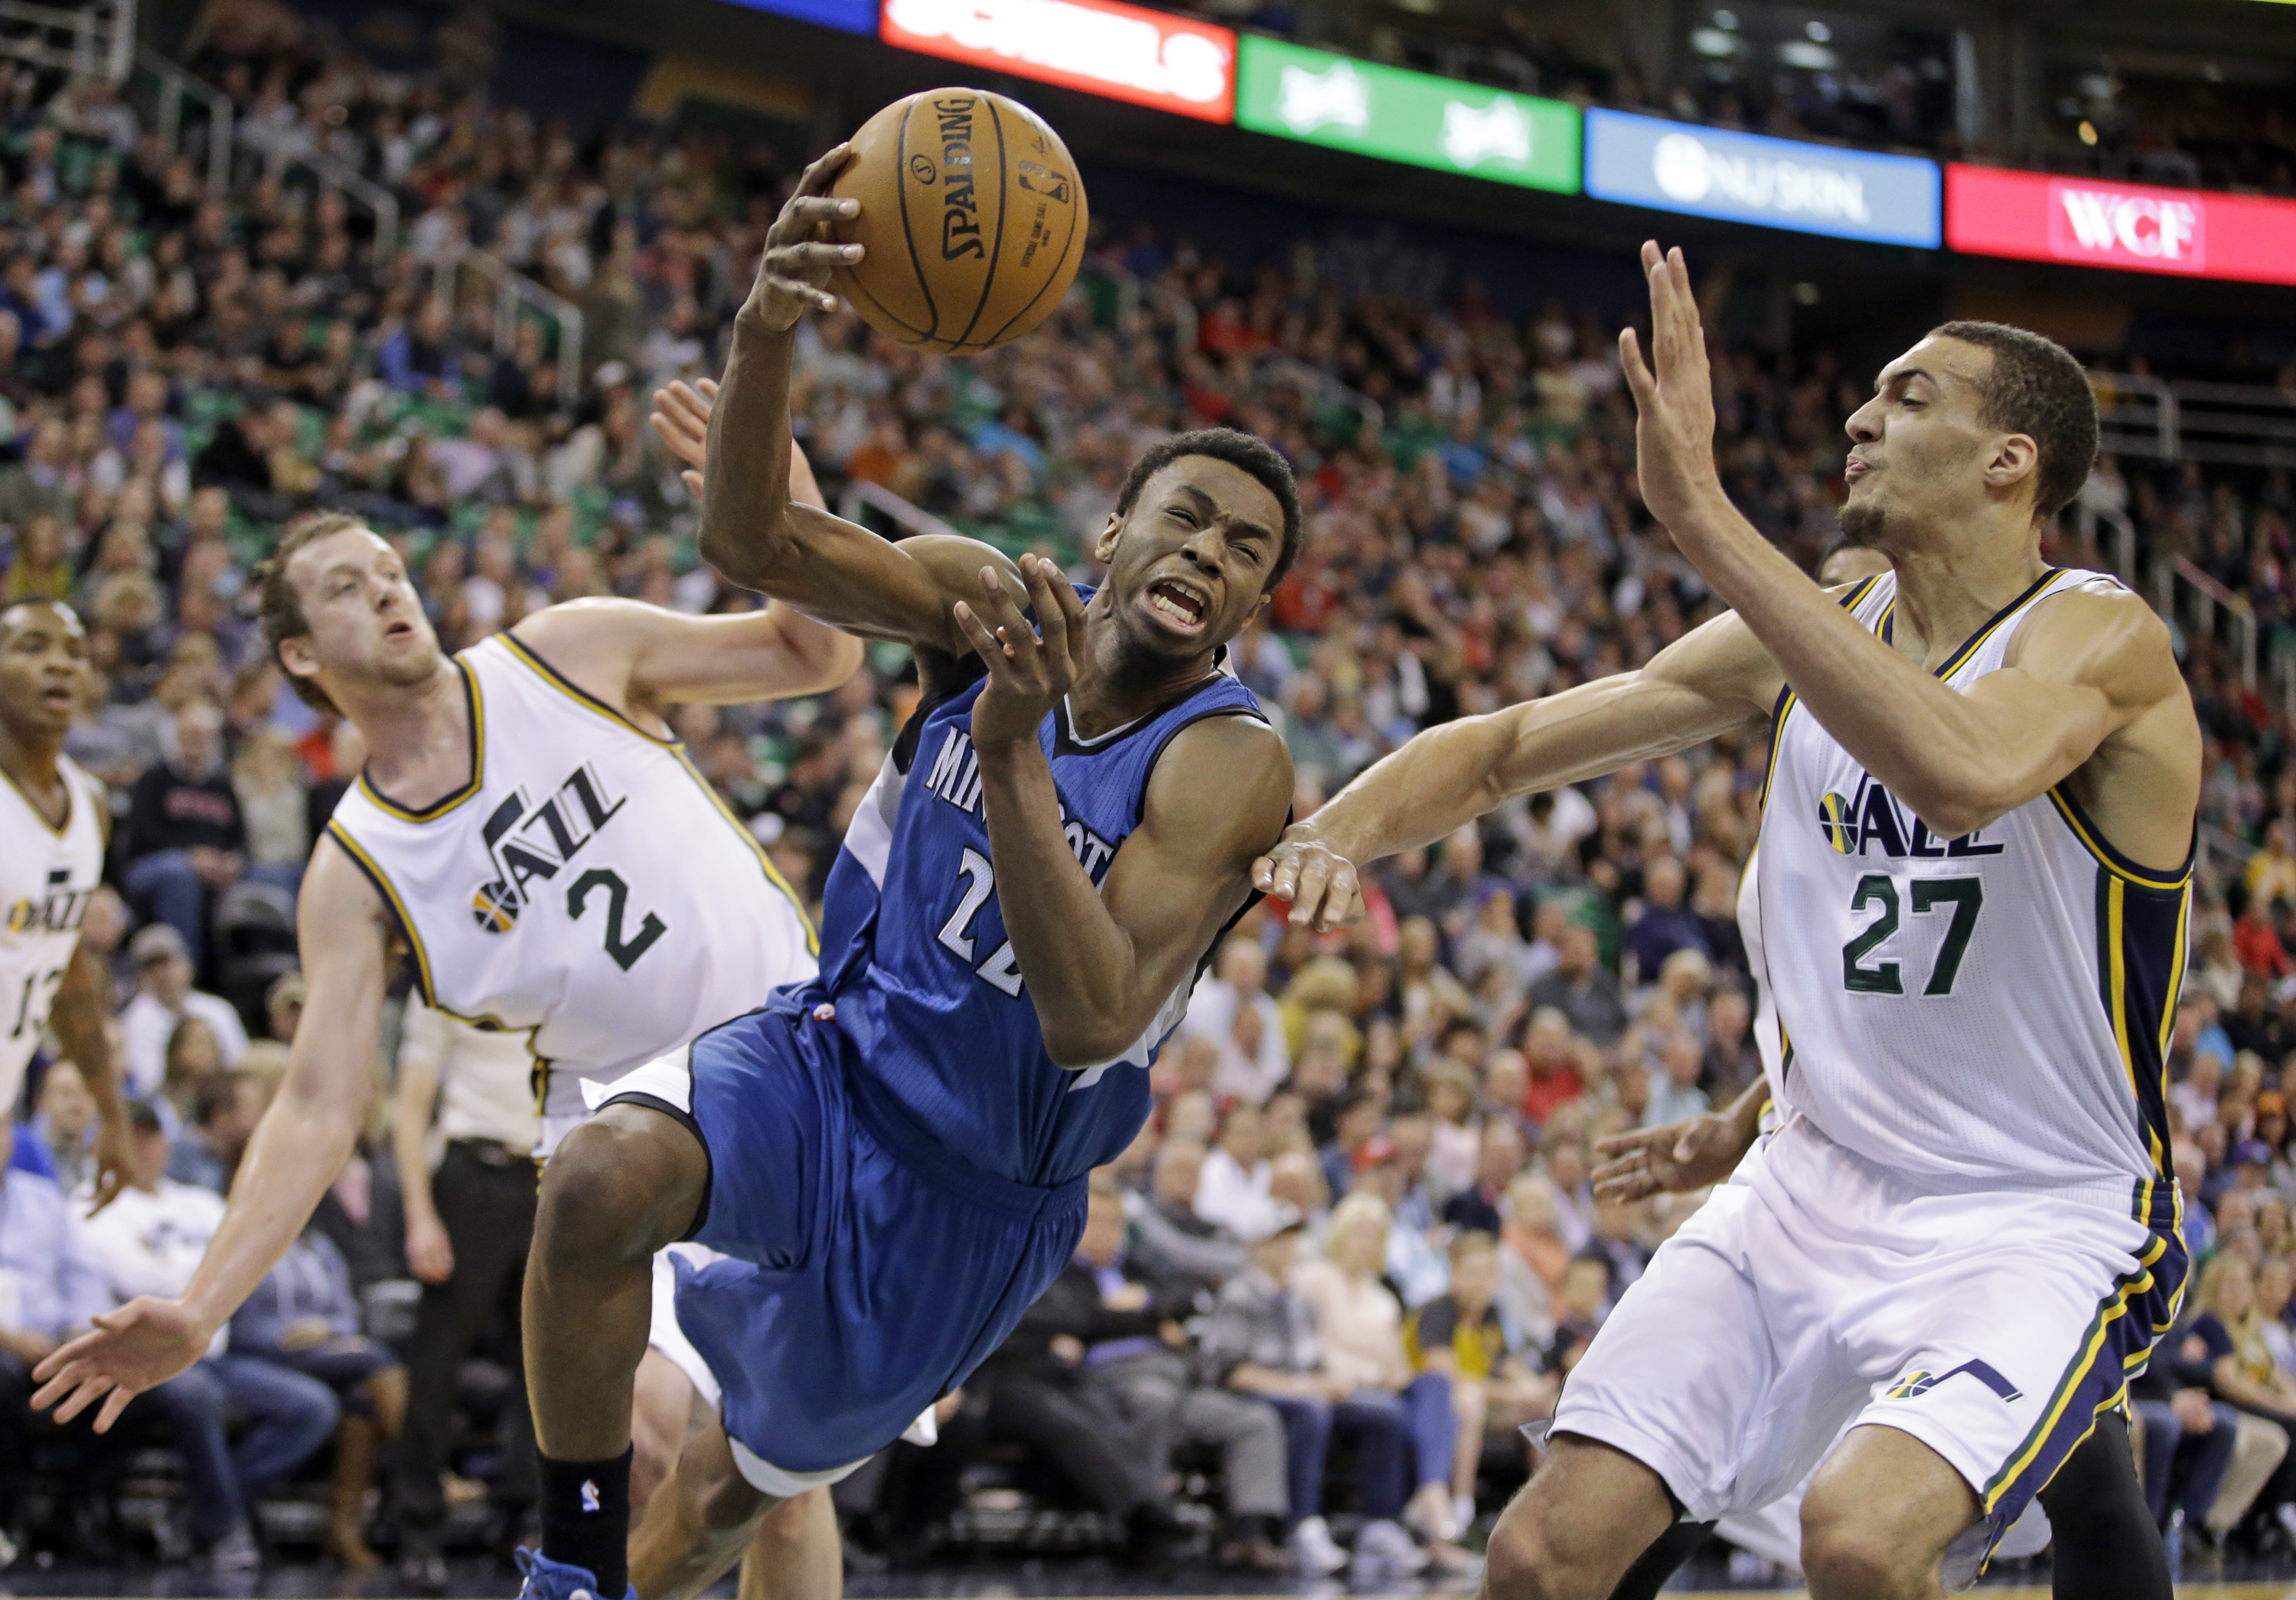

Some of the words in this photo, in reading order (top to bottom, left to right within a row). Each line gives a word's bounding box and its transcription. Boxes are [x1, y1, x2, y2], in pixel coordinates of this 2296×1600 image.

[933, 96, 986, 261] SPALDING
[2060, 188, 2196, 260] WCF
[472, 760, 627, 934] JAZZ
[566, 868, 668, 972] 2
[1842, 874, 1985, 996] 27
